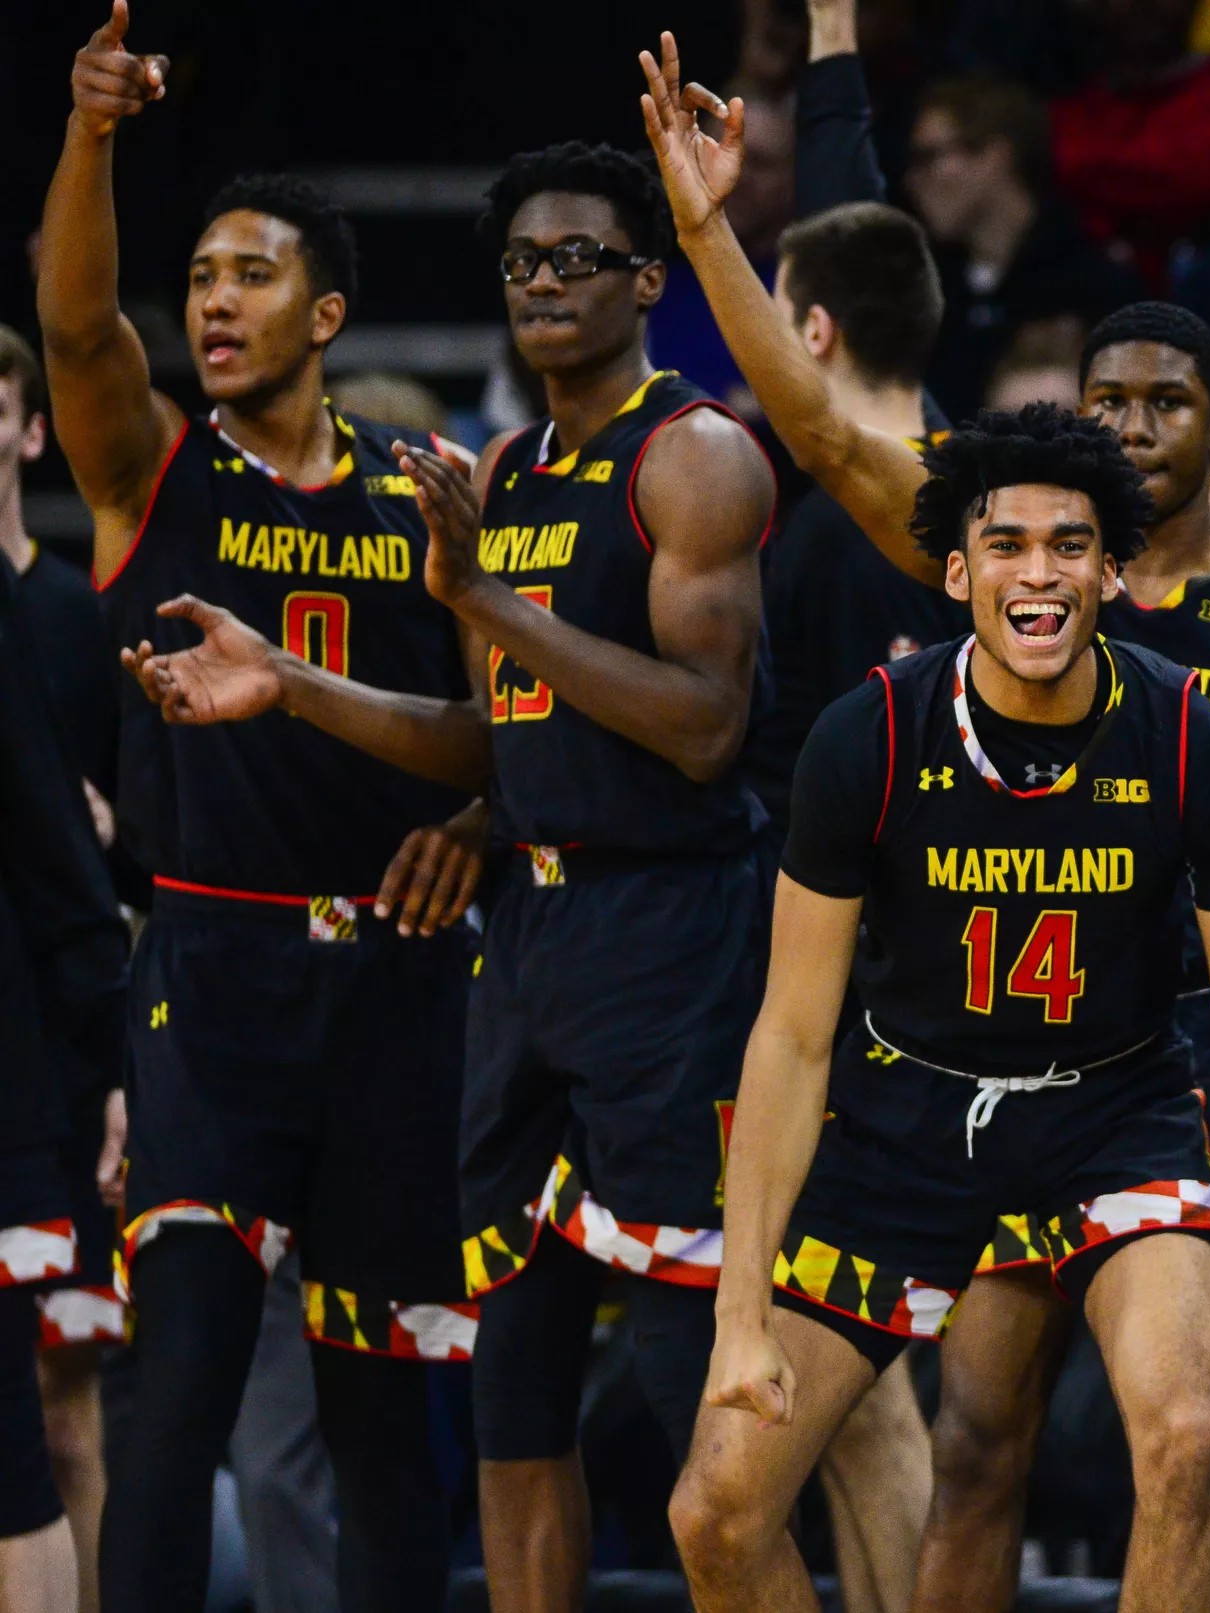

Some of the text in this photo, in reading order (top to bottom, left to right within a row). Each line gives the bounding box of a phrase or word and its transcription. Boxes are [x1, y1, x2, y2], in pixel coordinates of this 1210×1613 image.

[218, 517, 412, 582] MARYLAND
[927, 847, 1134, 893] MARYLAND
[960, 905, 1086, 1024] 14
